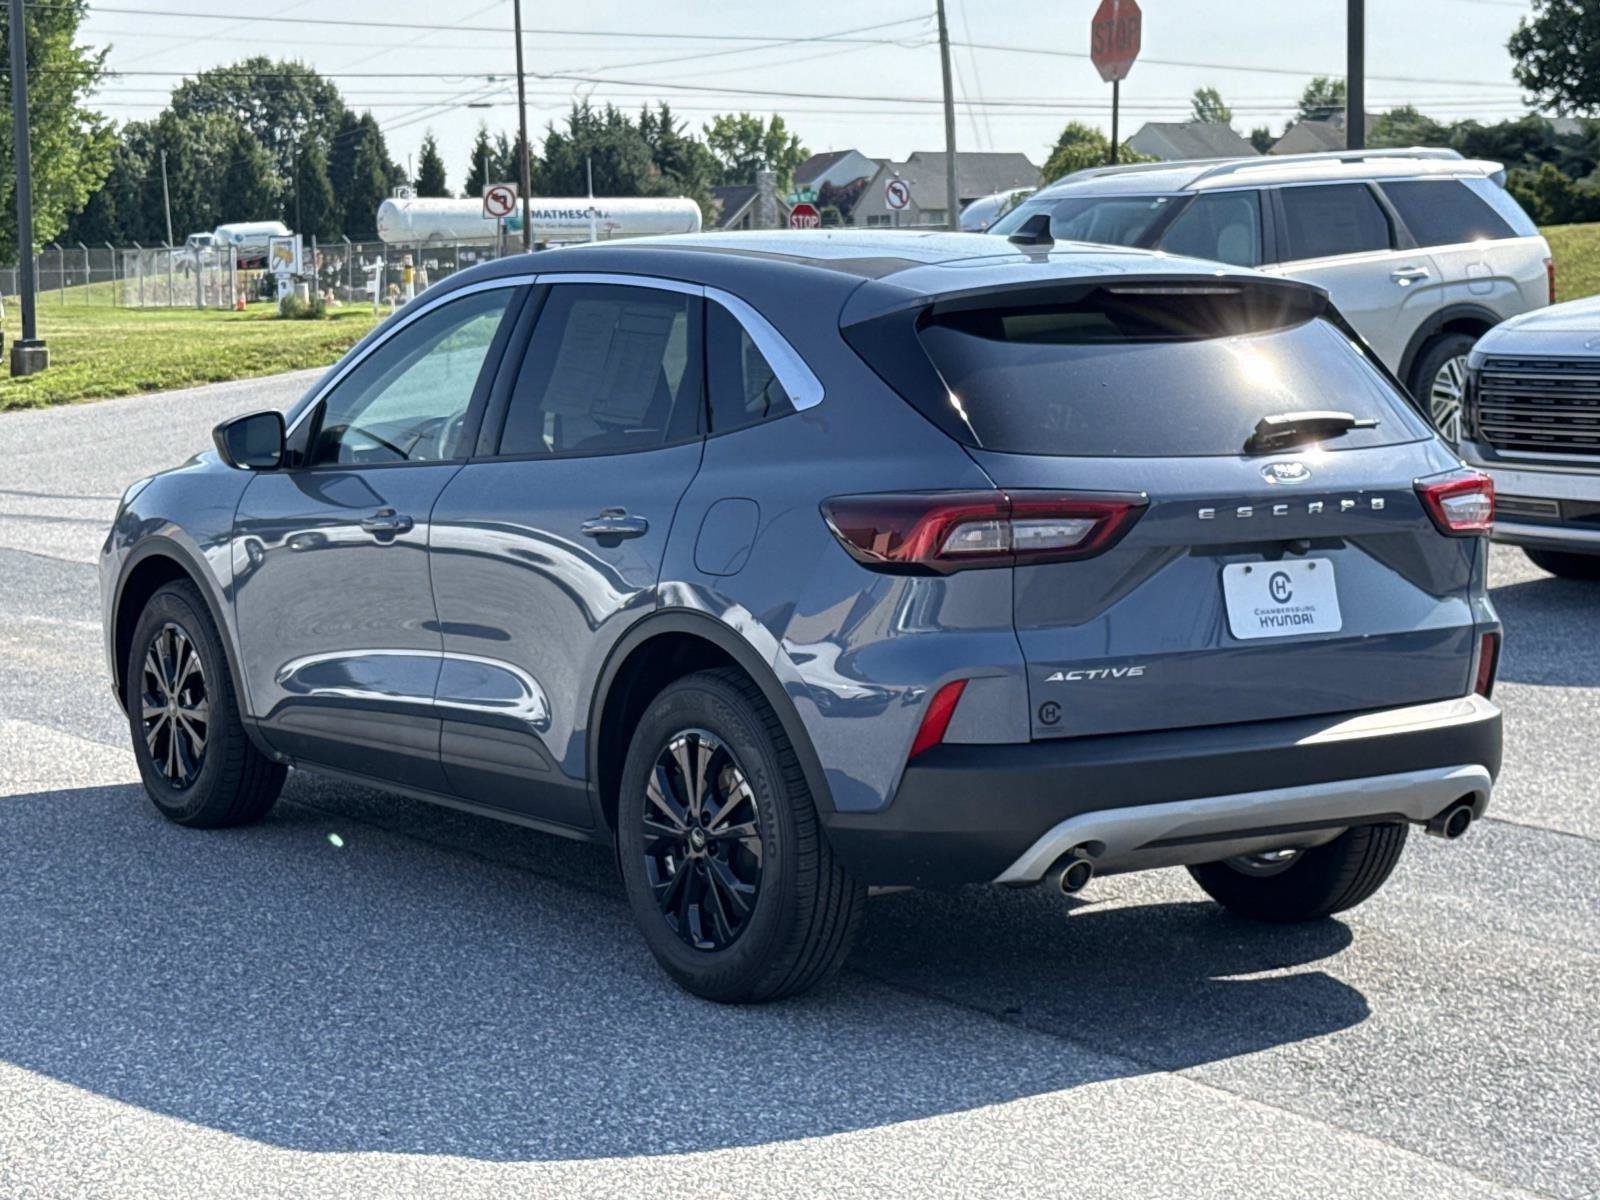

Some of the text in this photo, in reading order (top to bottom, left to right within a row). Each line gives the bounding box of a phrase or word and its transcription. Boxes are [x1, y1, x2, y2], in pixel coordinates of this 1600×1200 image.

[1092, 15, 1139, 54] STOP
[791, 215, 819, 230] STOP
[1198, 498, 1385, 519] ESCAPE
[1259, 613, 1315, 628] HYUNDAI
[1043, 665, 1147, 682] ACTIVE
[755, 767, 777, 859] KUMHO
